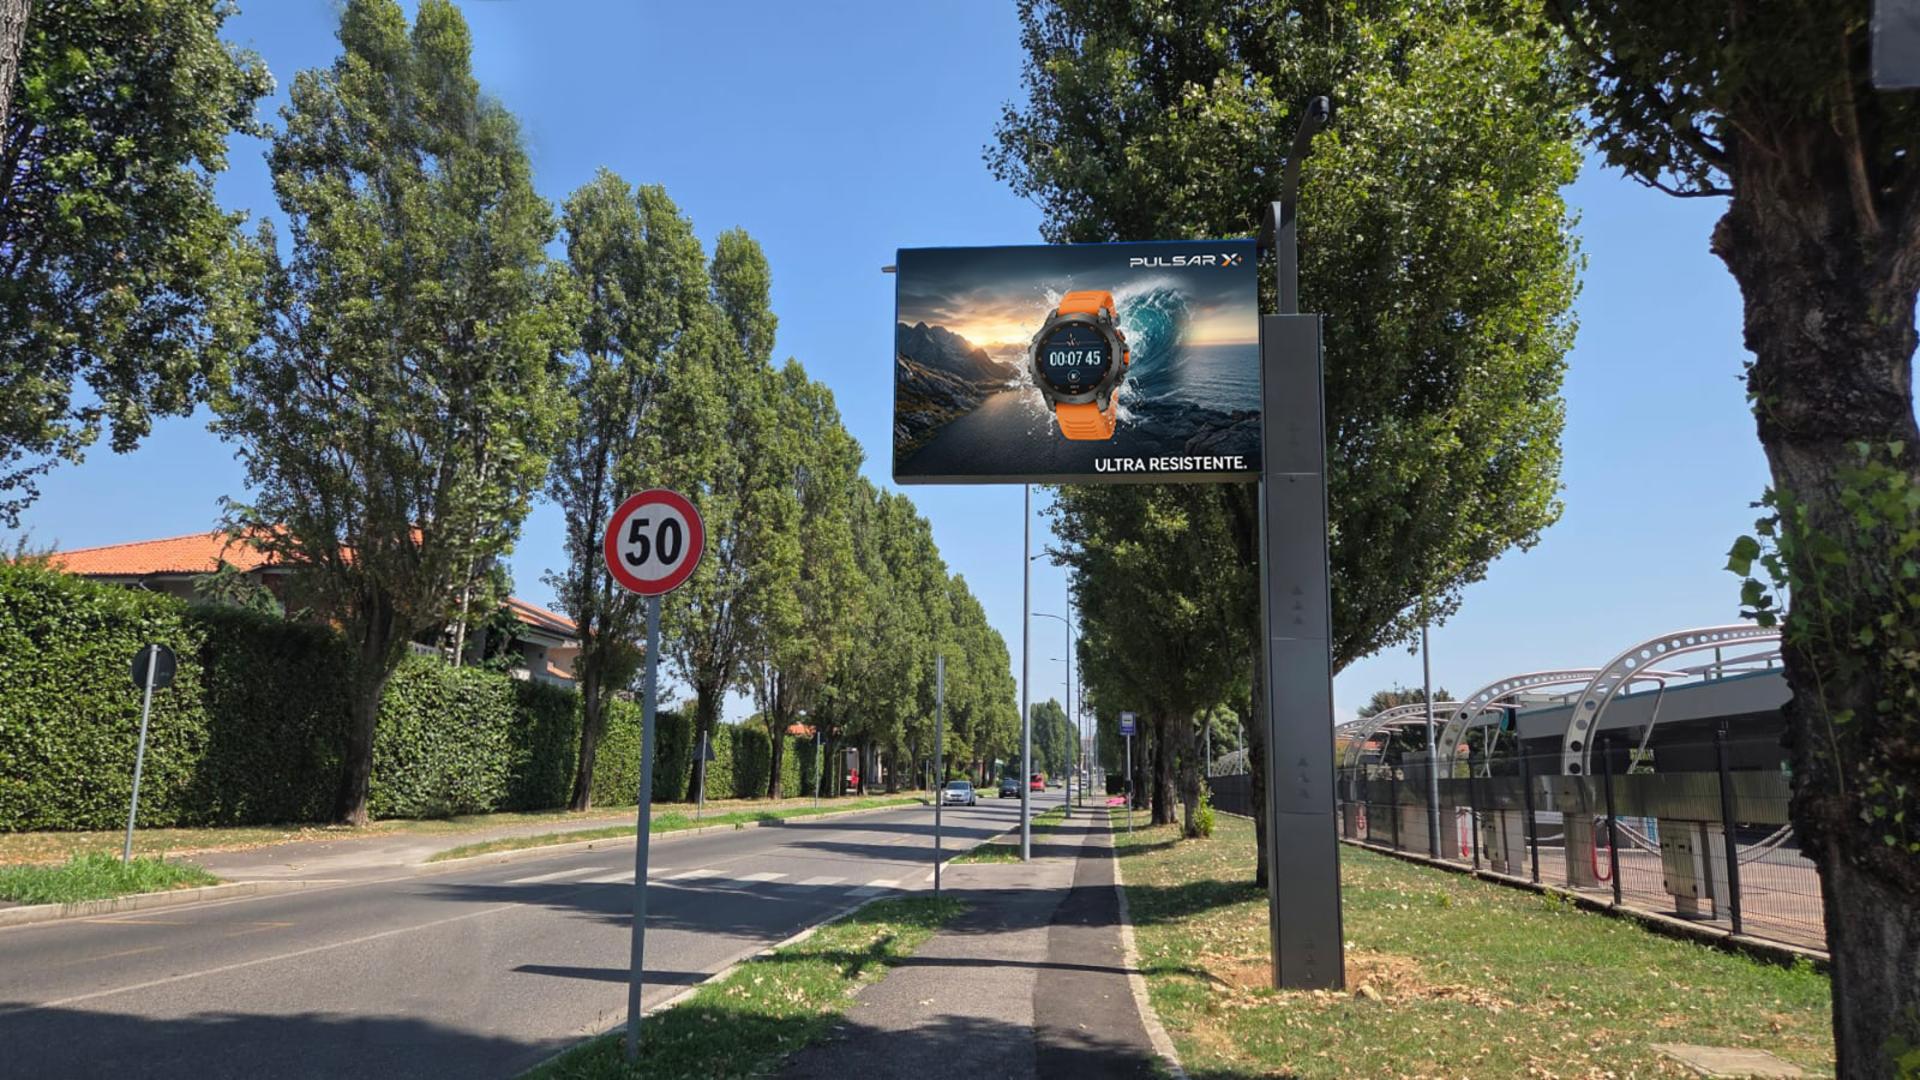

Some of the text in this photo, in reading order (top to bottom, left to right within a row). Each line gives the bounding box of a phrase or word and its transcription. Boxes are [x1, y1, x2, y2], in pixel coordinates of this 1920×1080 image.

[1129, 255, 1216, 268] PULSAR
[1095, 456, 1248, 472] ULTRA RESISTENTE.
[625, 517, 682, 567] 50
